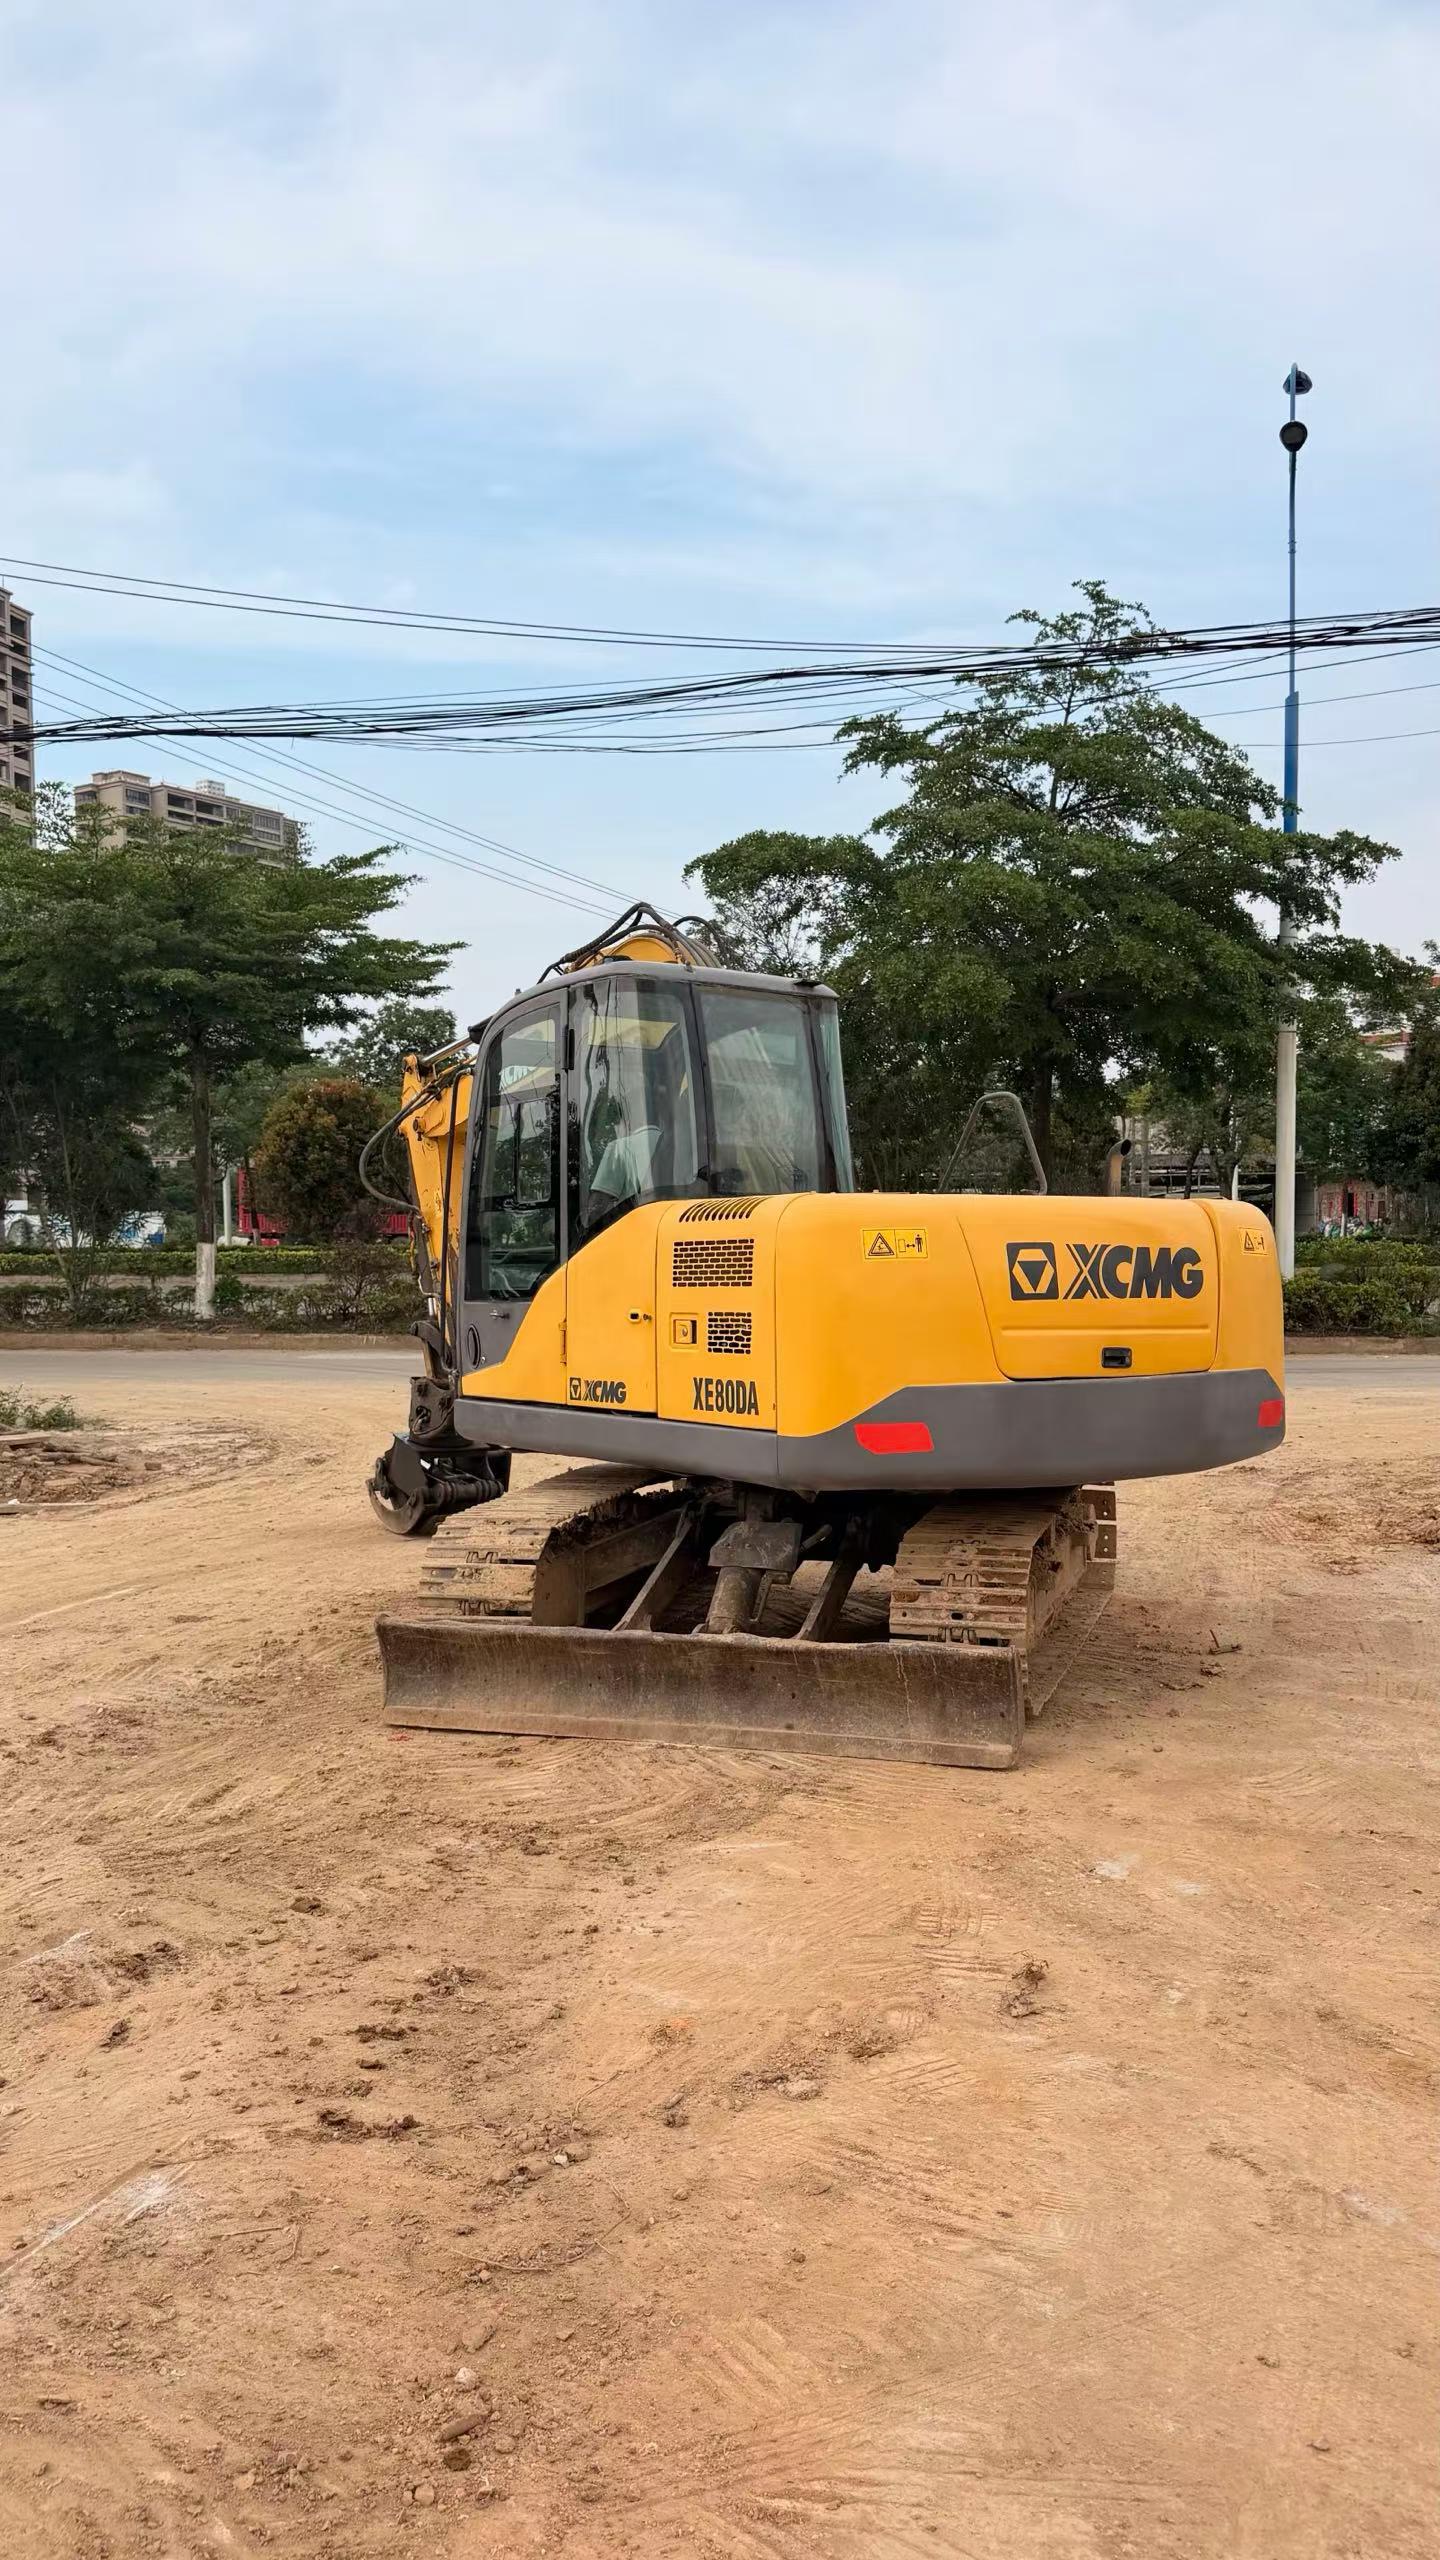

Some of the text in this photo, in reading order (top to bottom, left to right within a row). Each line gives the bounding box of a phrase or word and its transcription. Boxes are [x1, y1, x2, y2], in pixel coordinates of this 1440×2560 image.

[1062, 1243, 1204, 1300] XCMG
[582, 1379, 627, 1404] XCMG
[693, 1377, 760, 1416] XE80DA
